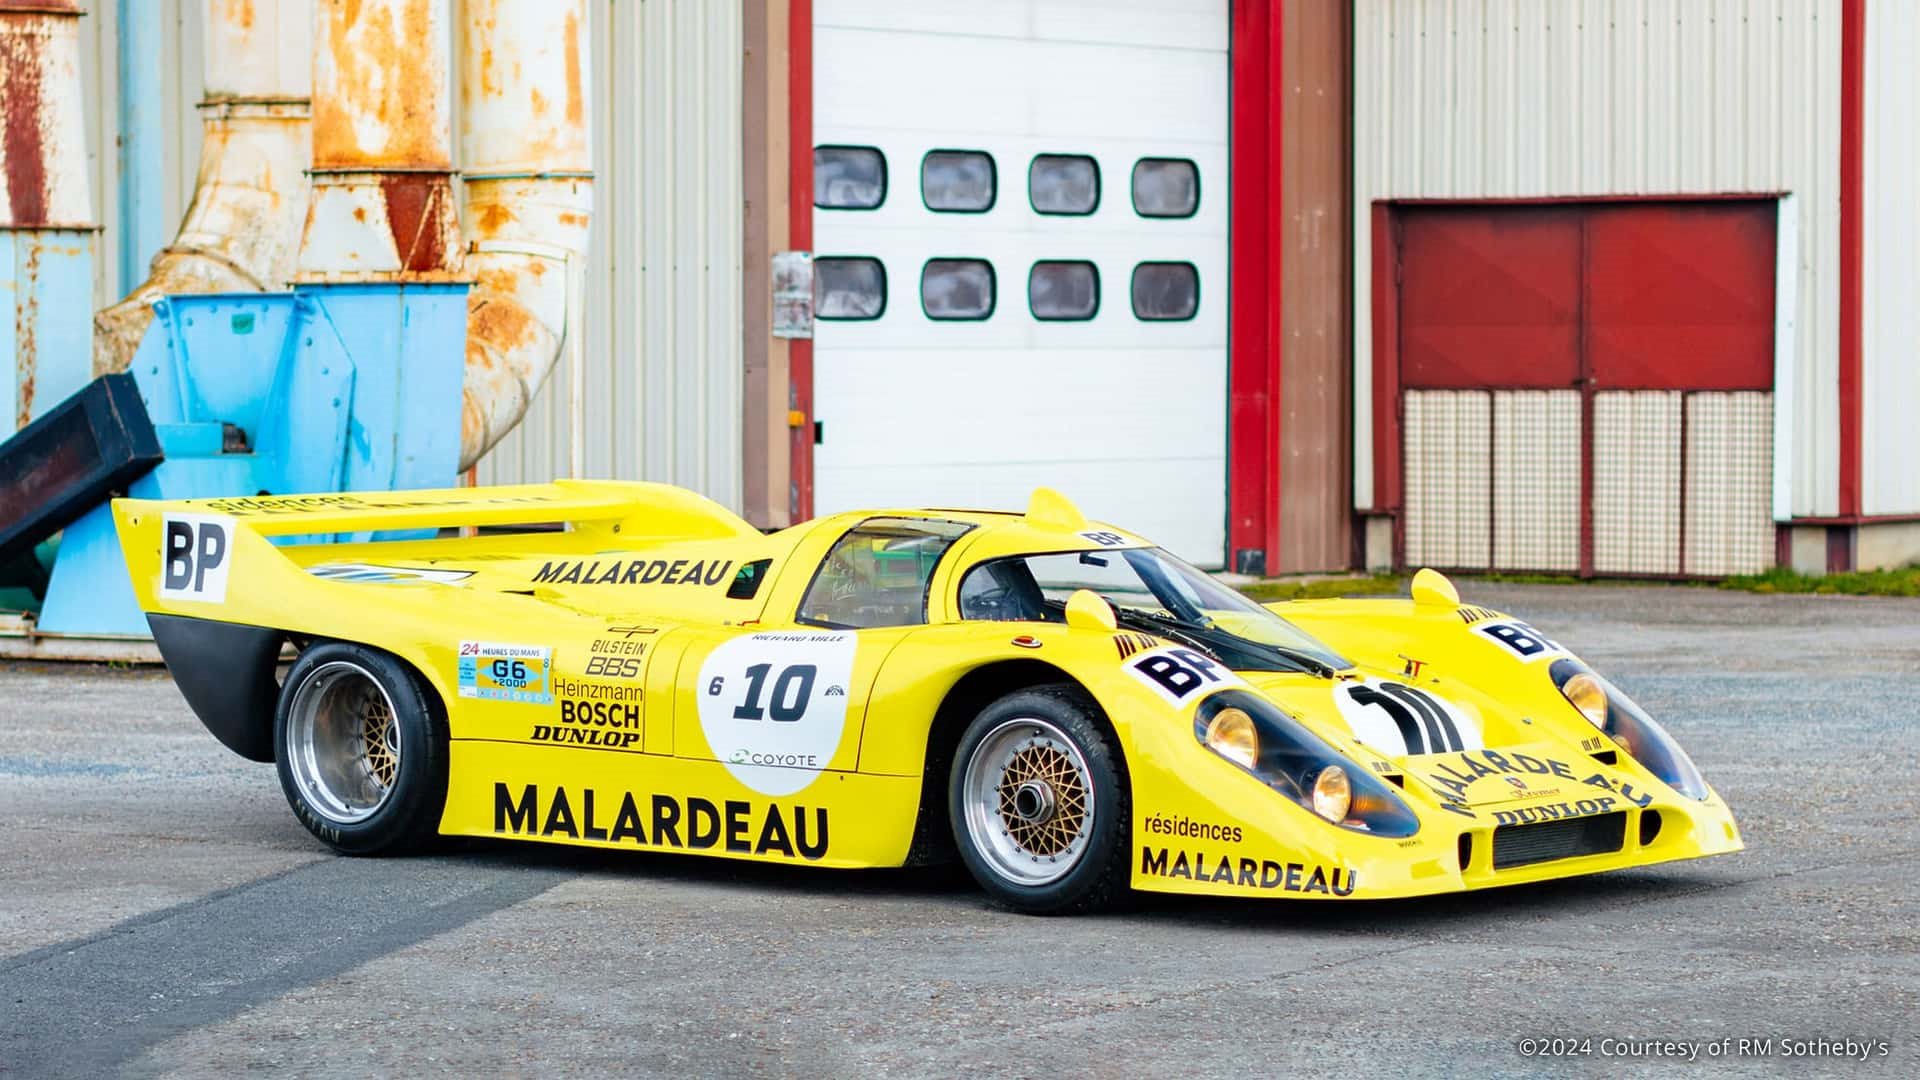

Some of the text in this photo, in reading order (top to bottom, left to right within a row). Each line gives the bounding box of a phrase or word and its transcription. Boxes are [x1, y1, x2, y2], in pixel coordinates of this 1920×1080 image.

[206, 496, 364, 511] sidences
[1080, 532, 1125, 545] BP
[164, 520, 226, 592] BP
[531, 560, 733, 586] MALARDEAU
[460, 643, 479, 655] 24
[482, 648, 507, 656] HEURES
[591, 640, 647, 655] BILSTEIN
[492, 659, 526, 679] G6
[585, 656, 641, 678] BBS
[1134, 649, 1221, 699] BP
[493, 679, 527, 689] +2000
[554, 678, 643, 701] Heinzmann
[708, 676, 724, 696] 6
[733, 663, 817, 722] 10
[561, 700, 639, 728] BOSCH
[530, 725, 639, 748] DUNLOP
[752, 753, 816, 766] COYOTE
[494, 782, 829, 860] MALARDEAU
[1492, 797, 1617, 826] DUNLOP
[1144, 813, 1243, 842] résidences
[1141, 846, 1357, 897] MALARDEAU
